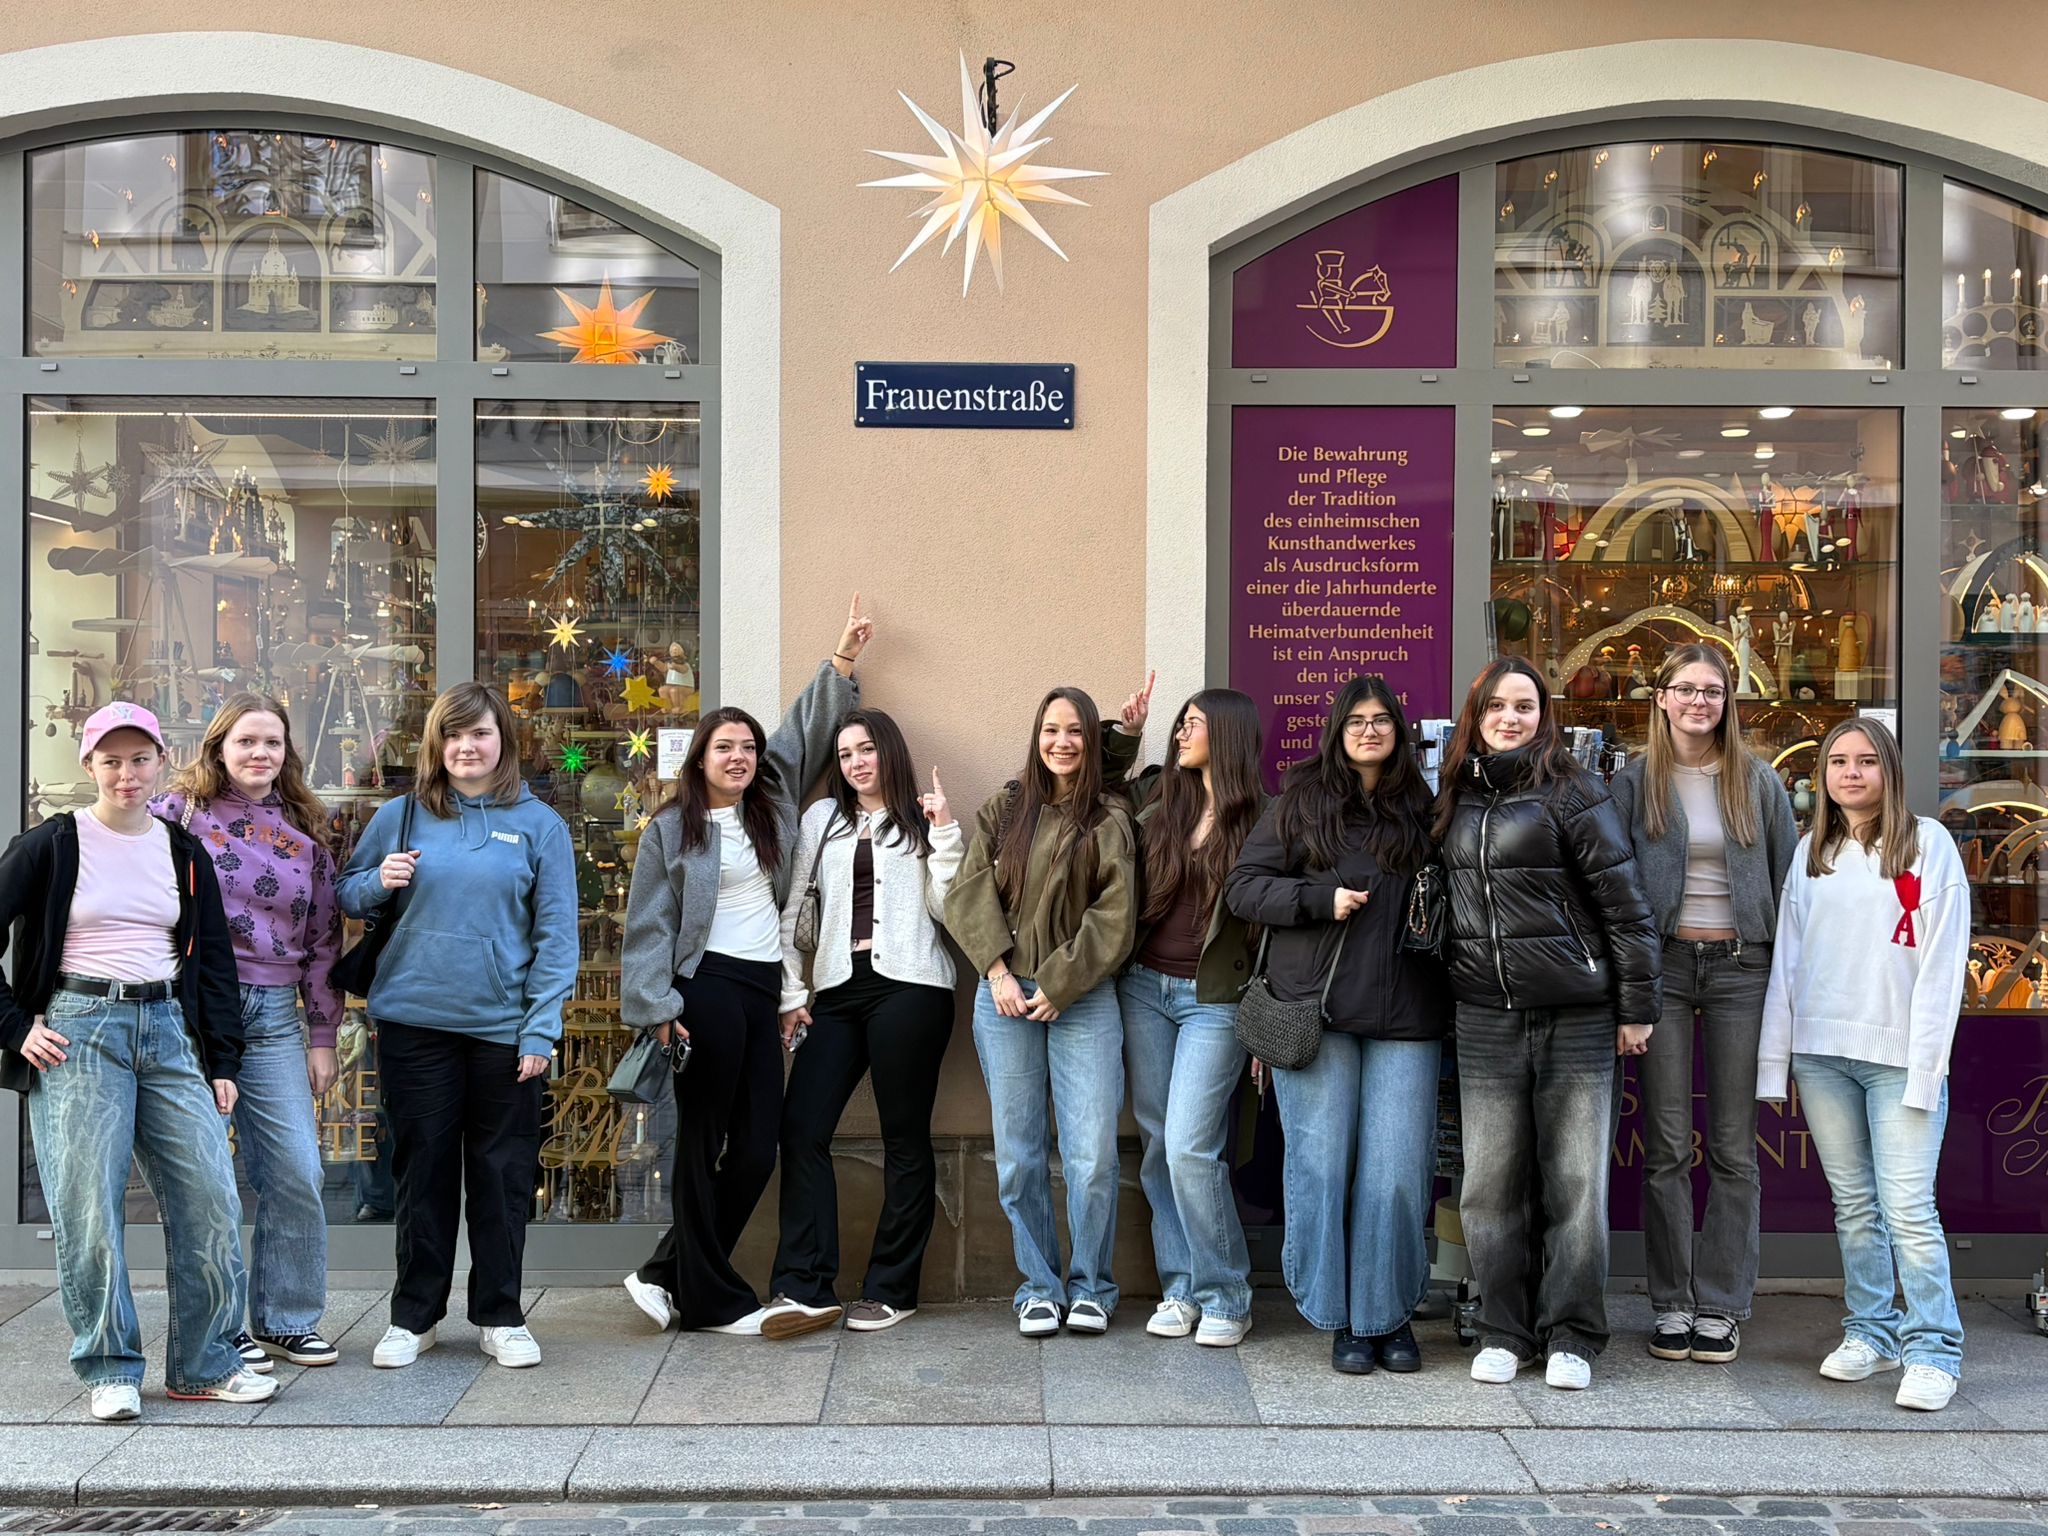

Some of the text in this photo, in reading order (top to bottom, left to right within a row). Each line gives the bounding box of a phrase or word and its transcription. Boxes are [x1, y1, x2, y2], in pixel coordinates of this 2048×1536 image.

[865, 379, 1064, 412] Frauenstraße
[1278, 445, 1408, 467] Die Bewahrung
[1298, 467, 1387, 489] und Pflege
[1288, 490, 1396, 506] der Tradition
[1263, 512, 1420, 528] des einheimischen
[1268, 534, 1416, 551] Kunsthandwerkes
[1263, 556, 1419, 573] als Ausdrucksform
[1246, 578, 1437, 597] einer die Jahrhunderte
[1282, 600, 1401, 617] überdauernde
[1249, 623, 1433, 639] Heimatverbundenheit
[1273, 645, 1408, 665] ist ein Anspruch
[1297, 667, 1328, 683] den
[1334, 667, 1358, 683] ich
[1273, 694, 1320, 705] unser
[1287, 713, 1329, 732] geste
[1280, 733, 1312, 749] und
[490, 830, 520, 845] PUMA
